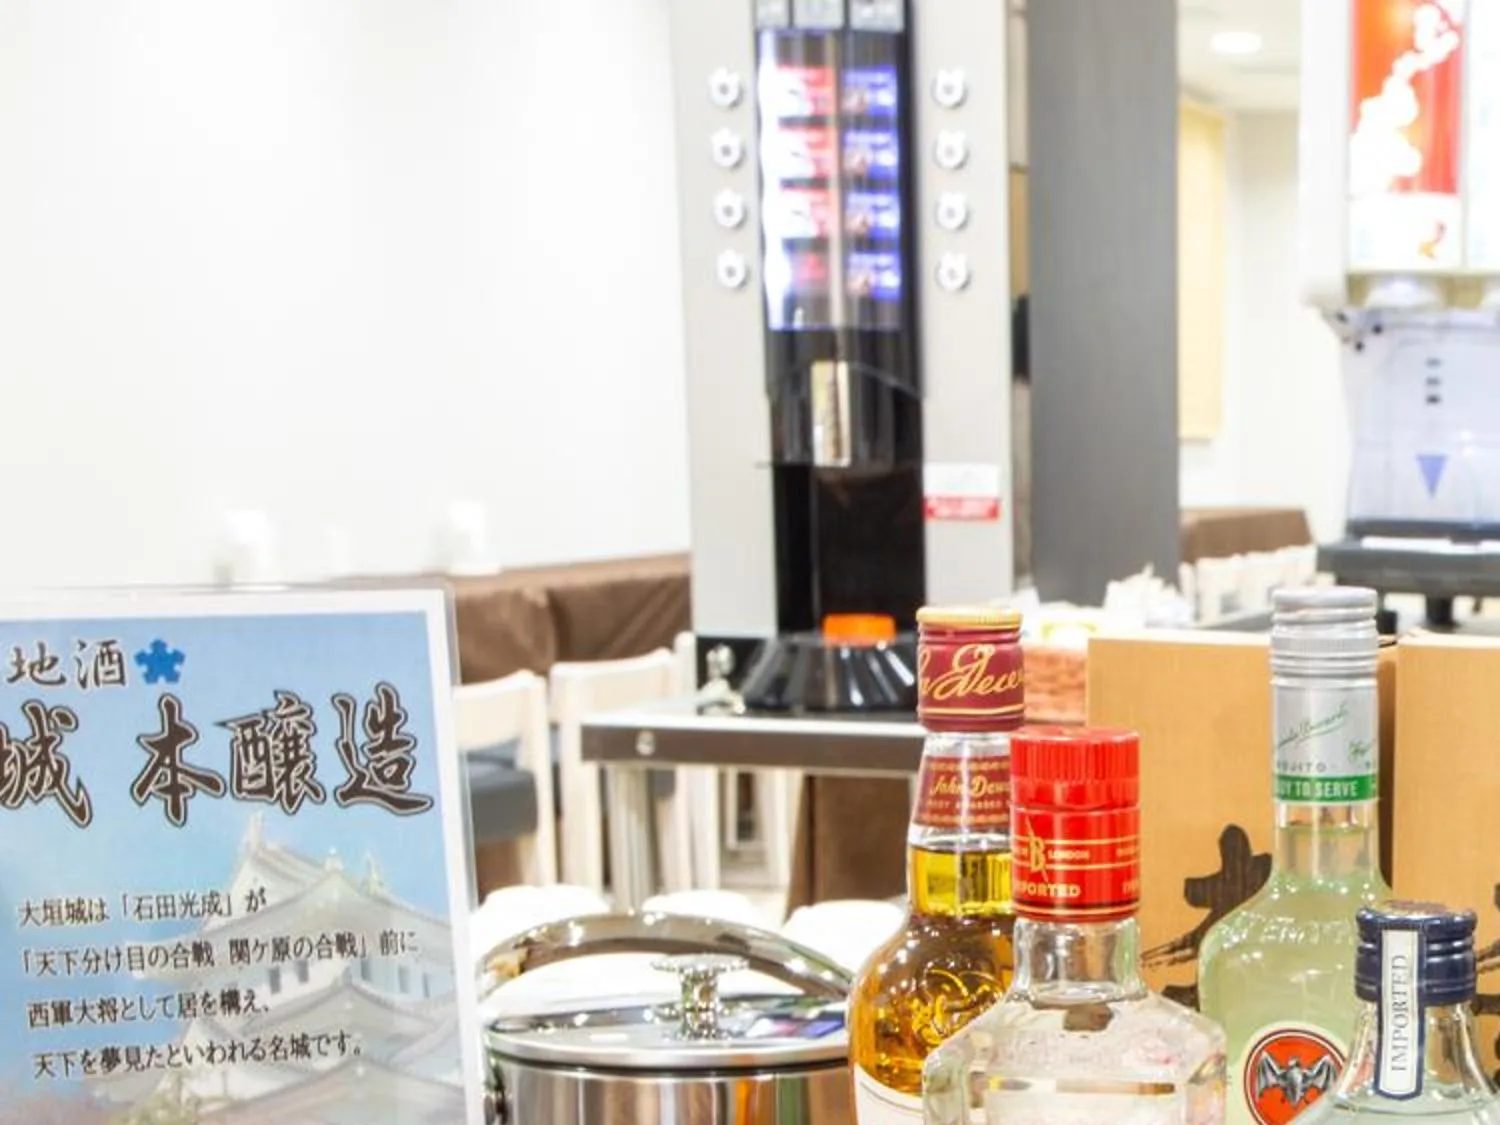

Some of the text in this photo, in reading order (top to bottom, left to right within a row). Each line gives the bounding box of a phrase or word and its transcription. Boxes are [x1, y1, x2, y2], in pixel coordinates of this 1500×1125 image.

[7, 638, 128, 689] 地酒
[131, 682, 434, 829] 本醸造
[1315, 780, 1358, 798] SERVE
[1391, 954, 1409, 1072] IMPORTED
